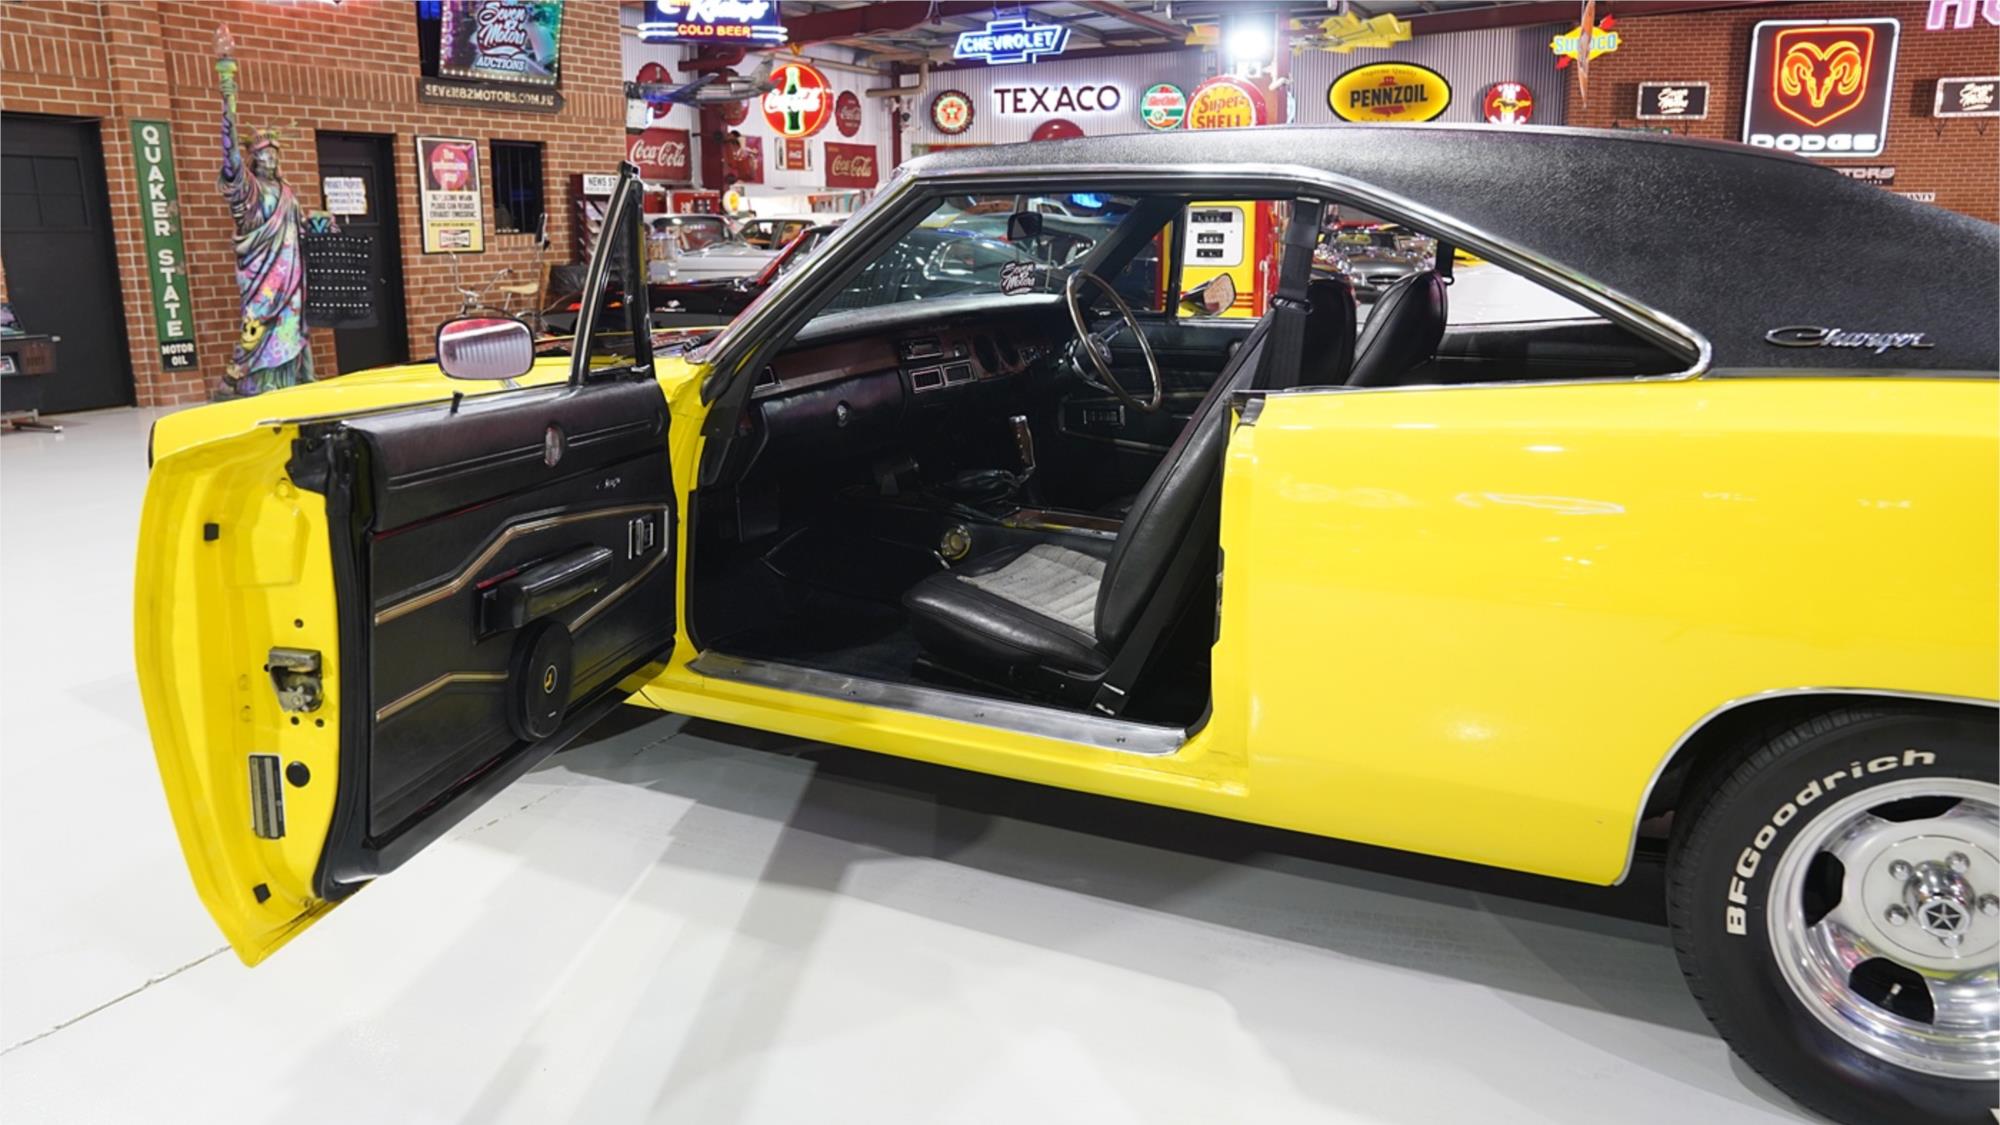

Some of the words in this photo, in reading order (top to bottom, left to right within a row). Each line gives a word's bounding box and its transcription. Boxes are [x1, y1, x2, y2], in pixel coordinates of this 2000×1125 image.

[480, 2, 525, 25] Seven
[480, 24, 525, 47] Motors
[677, 24, 714, 35] COLD
[716, 25, 751, 36] BEER
[962, 31, 1054, 52] CHEVROLET
[475, 57, 526, 71] AUCTIONS
[994, 85, 1121, 113] TEXACO
[1350, 84, 1428, 108] PENNZOIL
[630, 139, 685, 167] Coca-Cola
[1750, 134, 1877, 151] DODGE
[832, 155, 873, 177] Coca-Cola
[588, 177, 606, 187] NEWS
[142, 125, 171, 236] QUAKER
[158, 249, 184, 337] STATE
[161, 343, 194, 356] MOTOR
[1765, 325, 1936, 354] Charger
[171, 355, 189, 366] OIL
[1727, 749, 1936, 935] BFGoodrich
